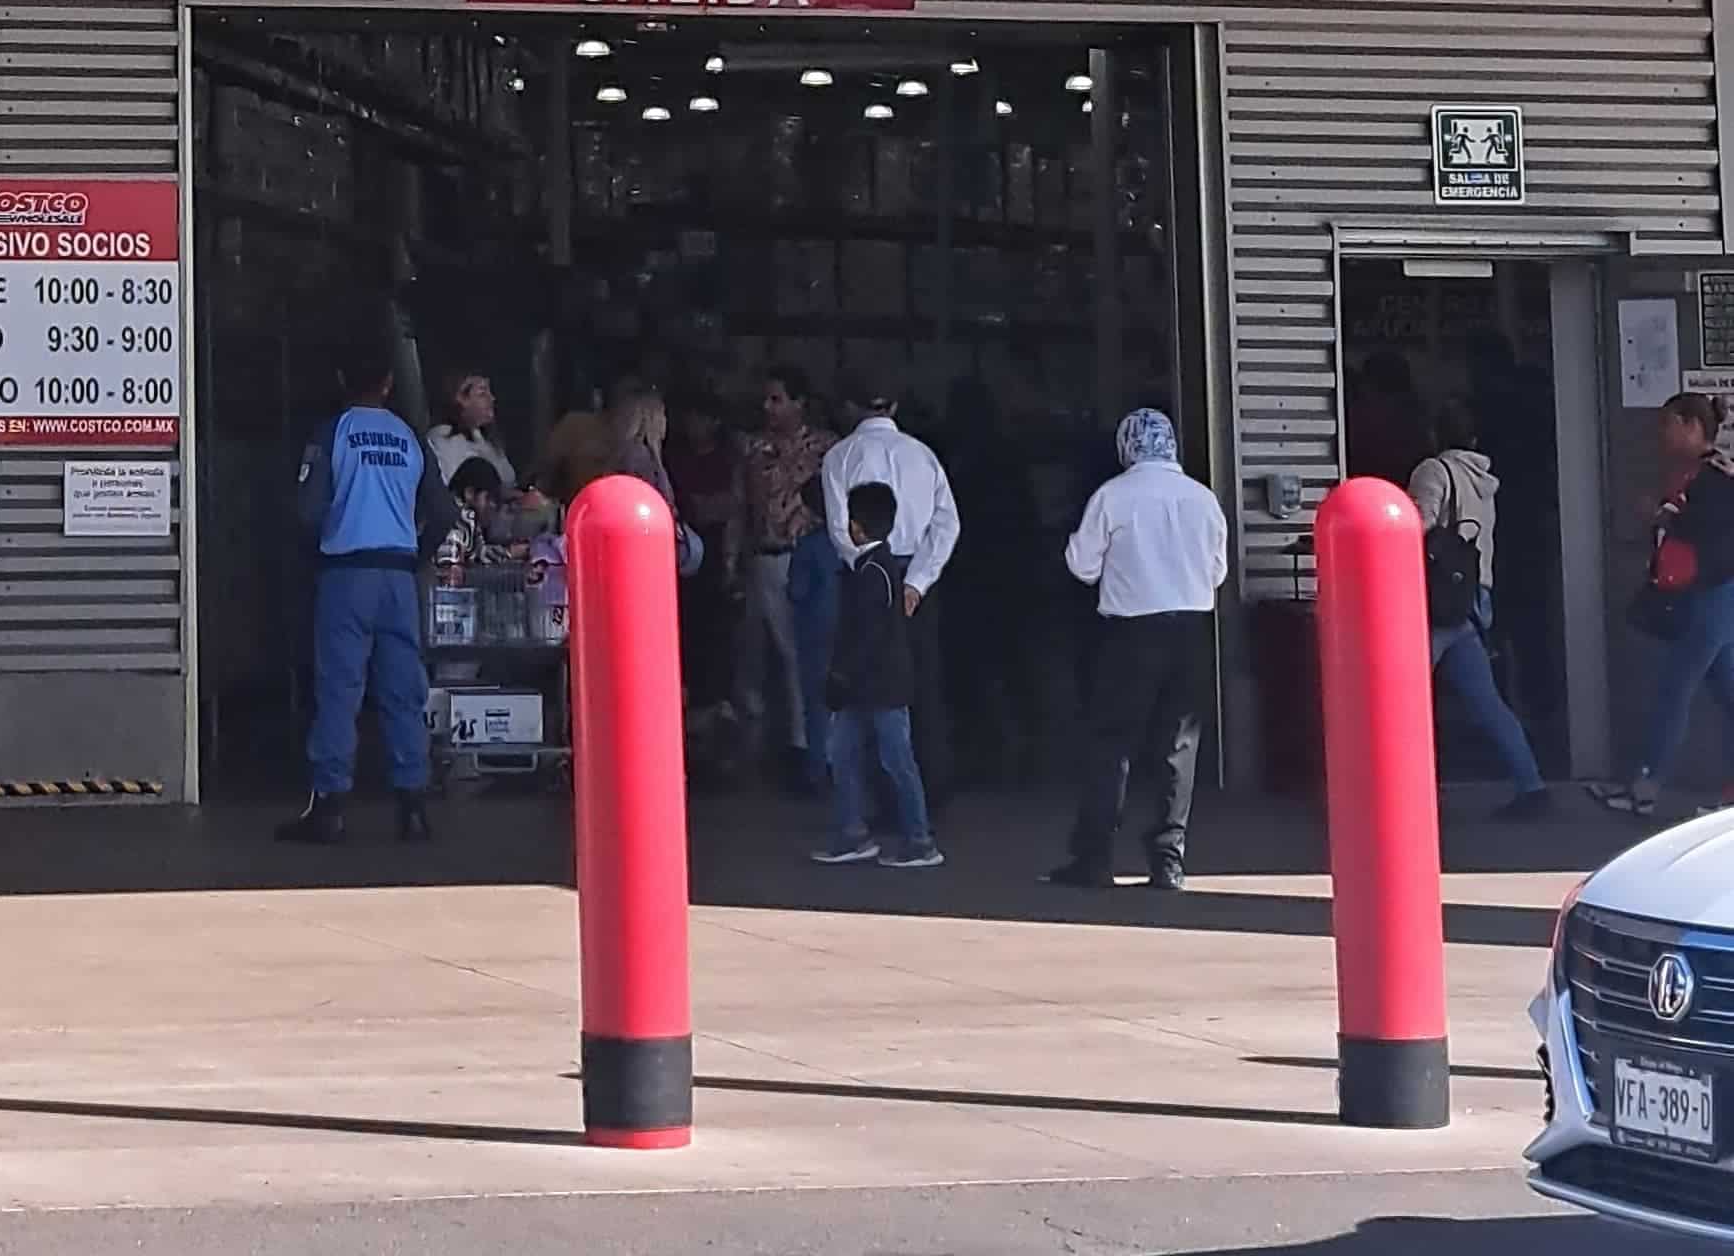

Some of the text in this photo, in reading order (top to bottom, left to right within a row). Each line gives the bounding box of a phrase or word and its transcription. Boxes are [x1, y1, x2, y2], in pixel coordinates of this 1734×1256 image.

[1493, 172, 1510, 184] DE
[1441, 186, 1519, 198] EMERGENCIA
[9, 213, 84, 224] WHOLESALE
[56, 232, 152, 258] SOCIOS
[34, 277, 100, 305] 10:00
[120, 278, 173, 305] 8:30
[46, 325, 100, 353] 9:30
[120, 325, 173, 353] 9:00
[34, 377, 100, 405] 10:00
[121, 378, 174, 405] 8:00
[33, 419, 175, 435] WWW.COSTCO.COM.MX
[1616, 1076, 1711, 1131] VFA-389-D
